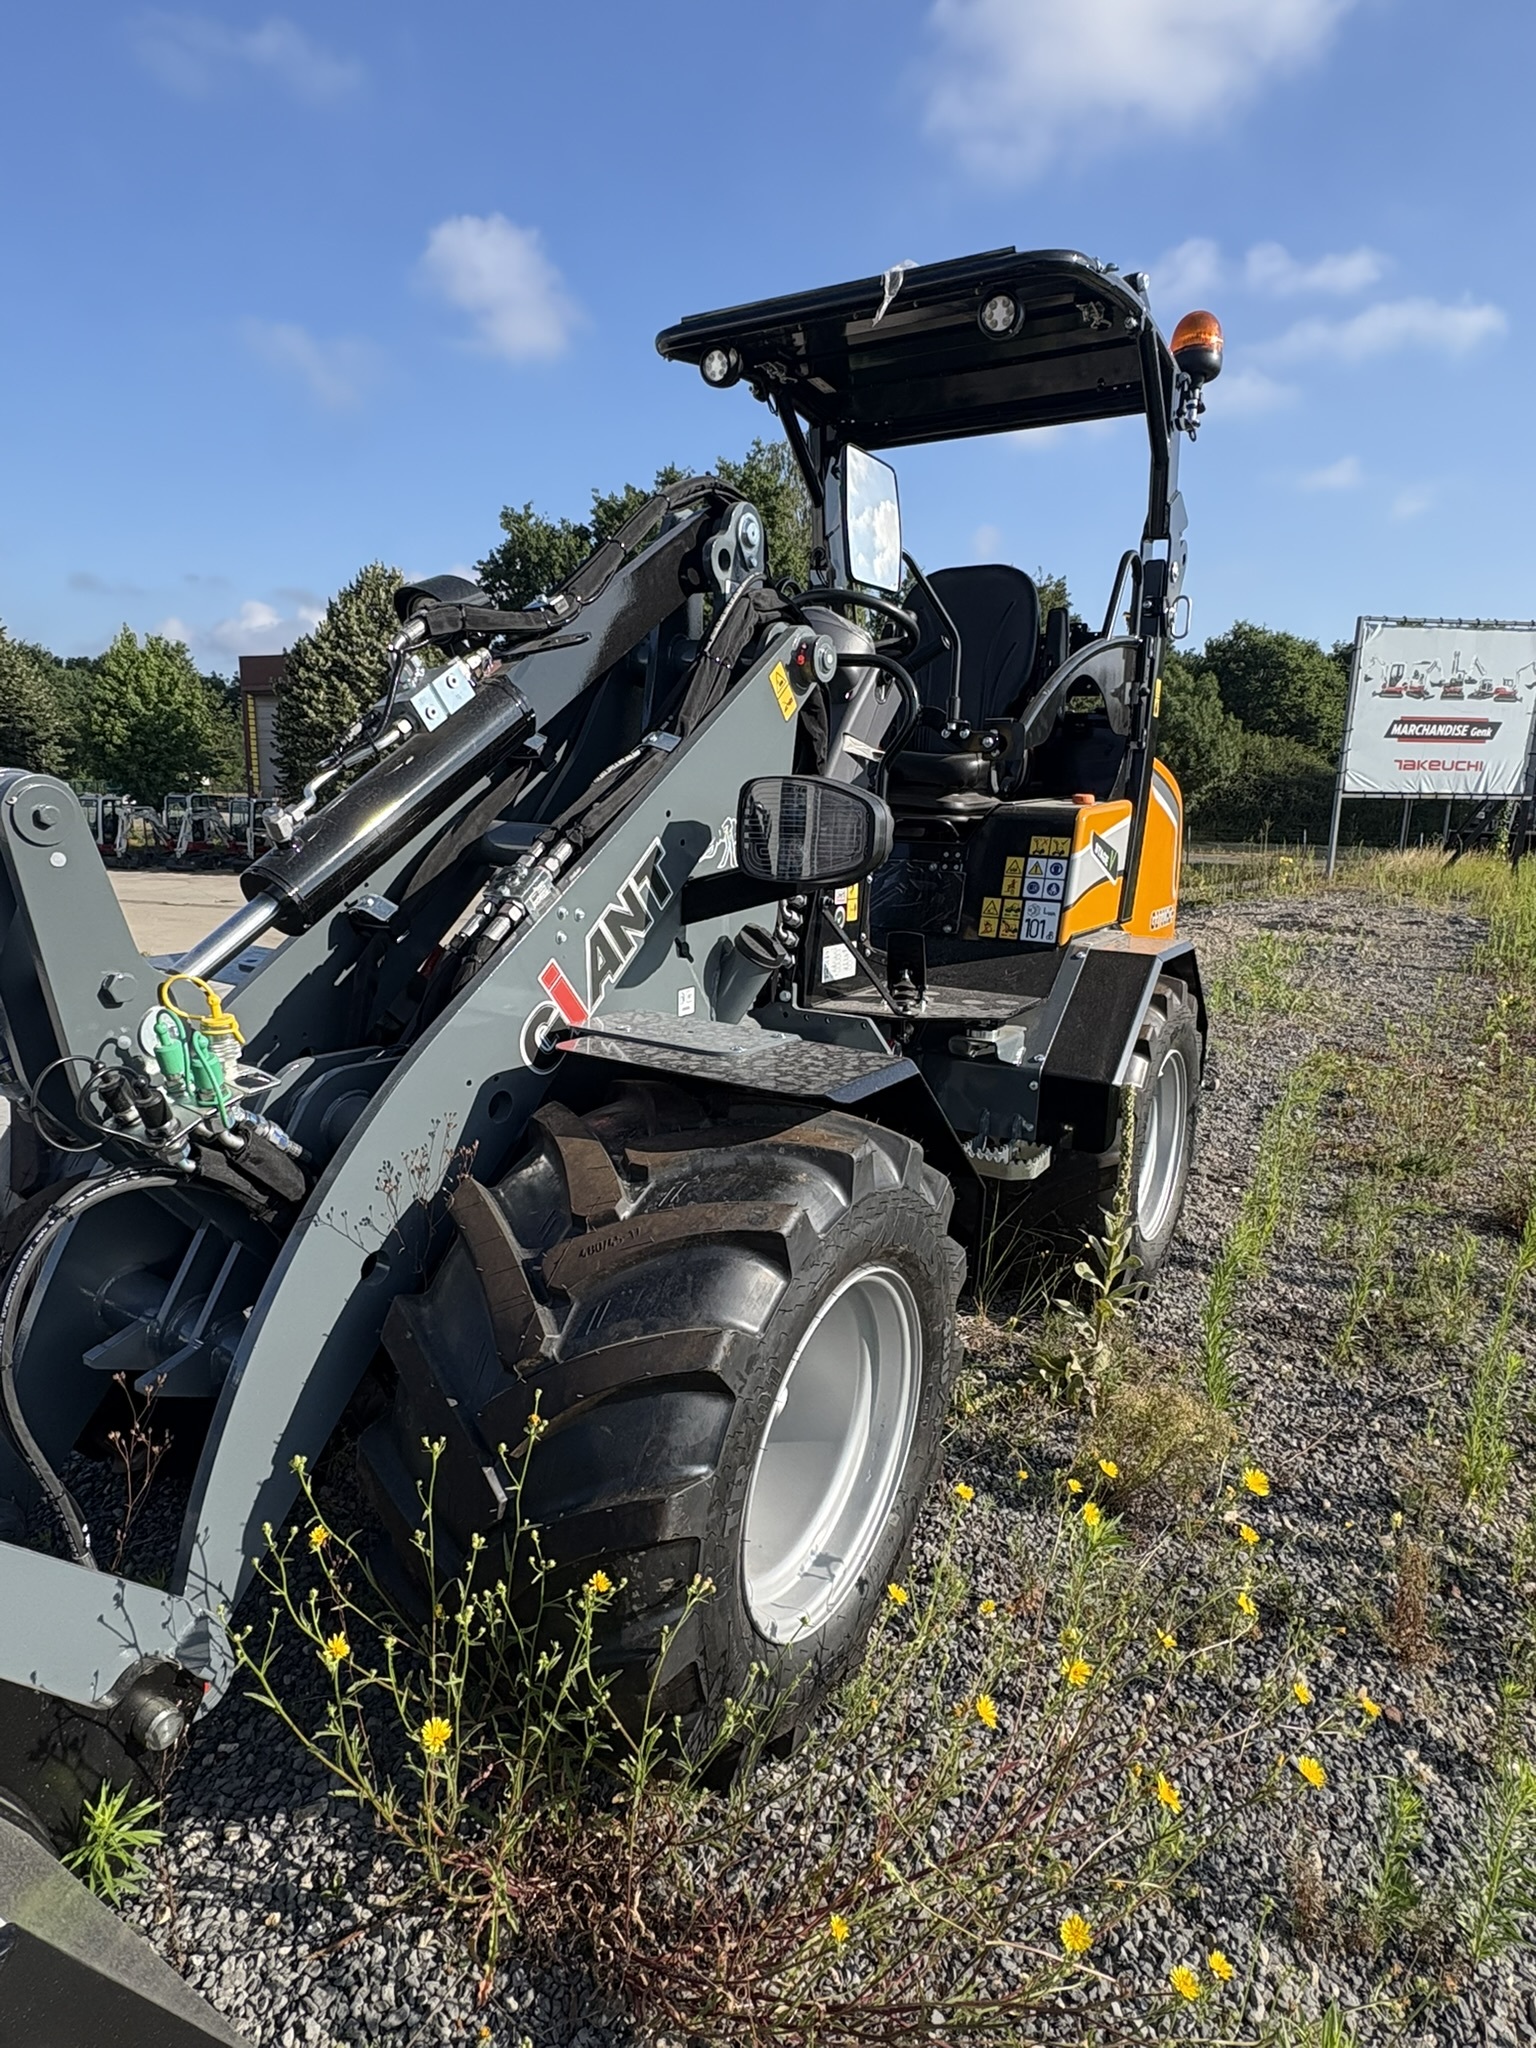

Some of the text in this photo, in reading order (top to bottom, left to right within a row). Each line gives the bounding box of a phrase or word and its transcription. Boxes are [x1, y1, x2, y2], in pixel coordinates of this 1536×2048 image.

[1390, 723, 1493, 737] MARCHANDISE Genk
[1394, 759, 1484, 772] TAKEUCHI
[1109, 850, 1118, 871] V
[1025, 918, 1046, 940] 101
